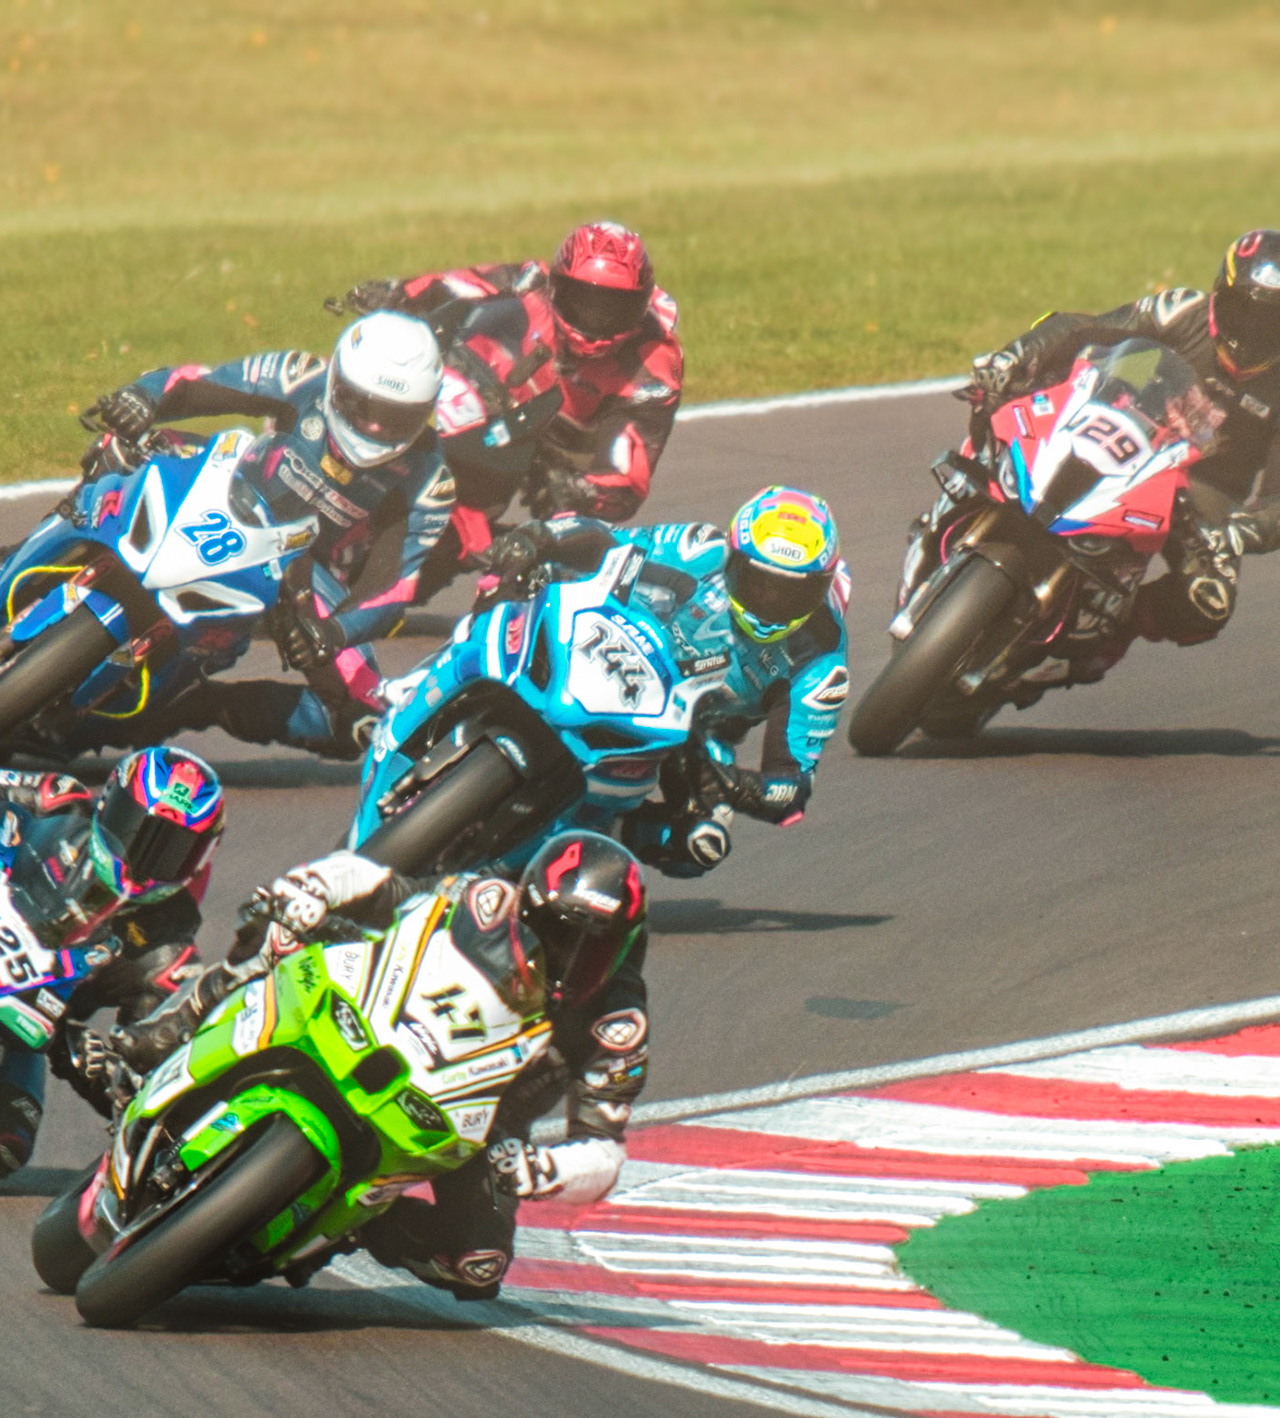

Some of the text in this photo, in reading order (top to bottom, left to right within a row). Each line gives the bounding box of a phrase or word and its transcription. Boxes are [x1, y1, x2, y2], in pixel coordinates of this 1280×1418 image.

[377, 375, 406, 393] SHOEI
[175, 509, 247, 567] 28
[769, 542, 802, 560] SHOEI
[573, 621, 650, 709] 144
[340, 950, 362, 982] BURY
[462, 1108, 489, 1129] BURY
